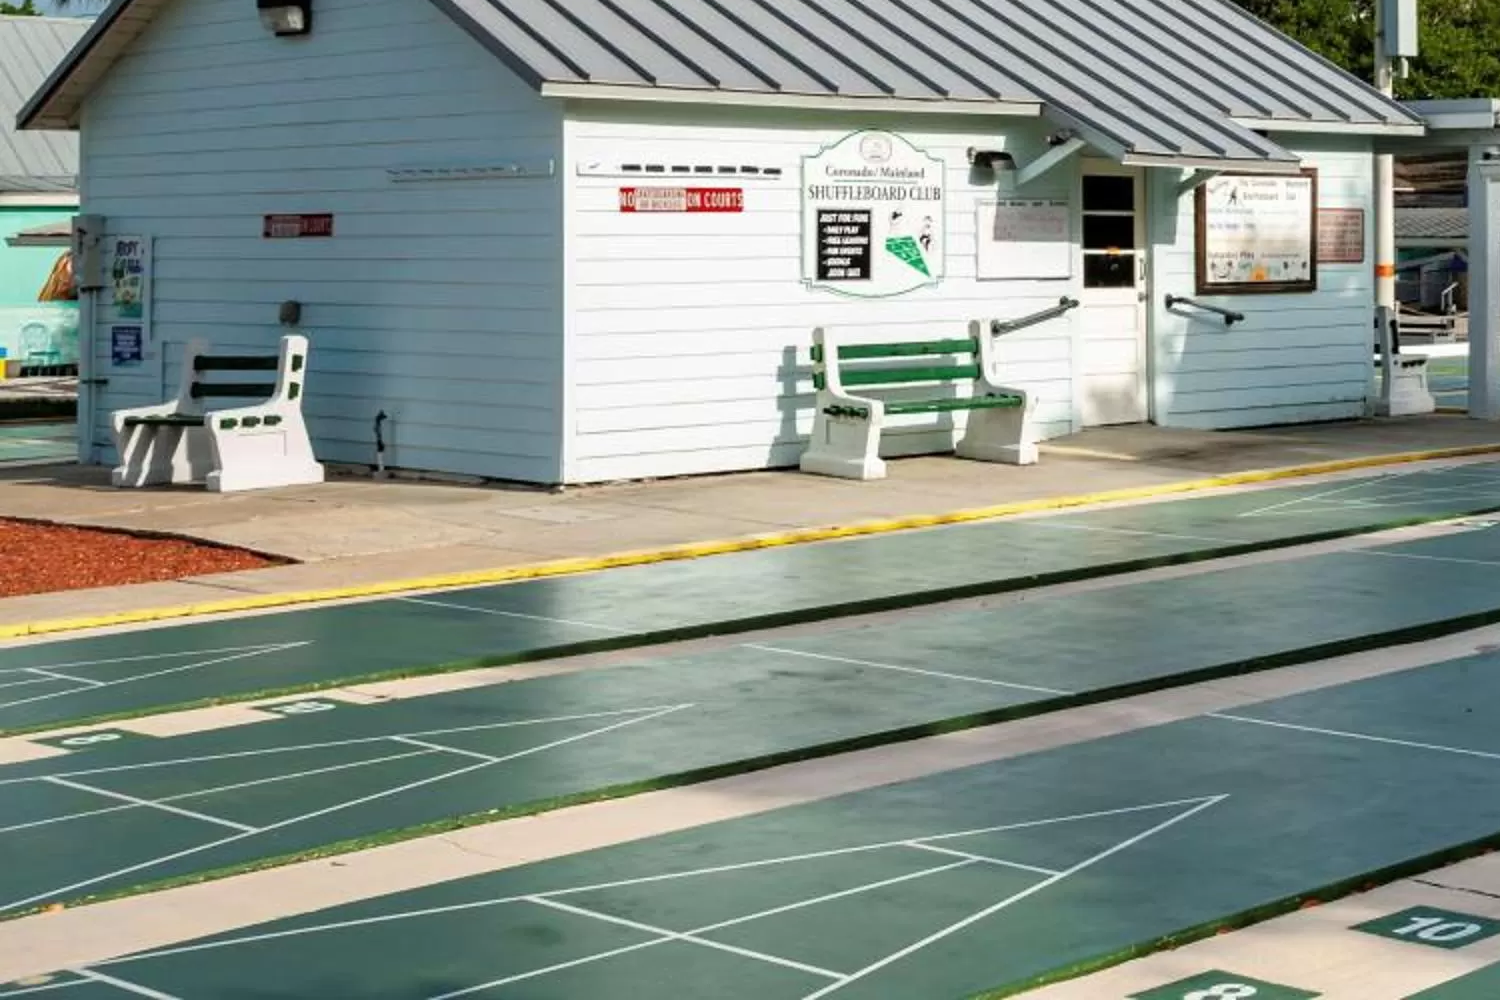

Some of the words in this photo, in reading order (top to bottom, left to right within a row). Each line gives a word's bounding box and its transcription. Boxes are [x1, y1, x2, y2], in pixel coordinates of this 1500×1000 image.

[703, 192, 744, 207] COURTS
[808, 185, 906, 200] SHUFFLEBOARD
[909, 186, 941, 200] CLUB
[1391, 916, 1483, 942] 10
[1183, 983, 1258, 1000] 8
